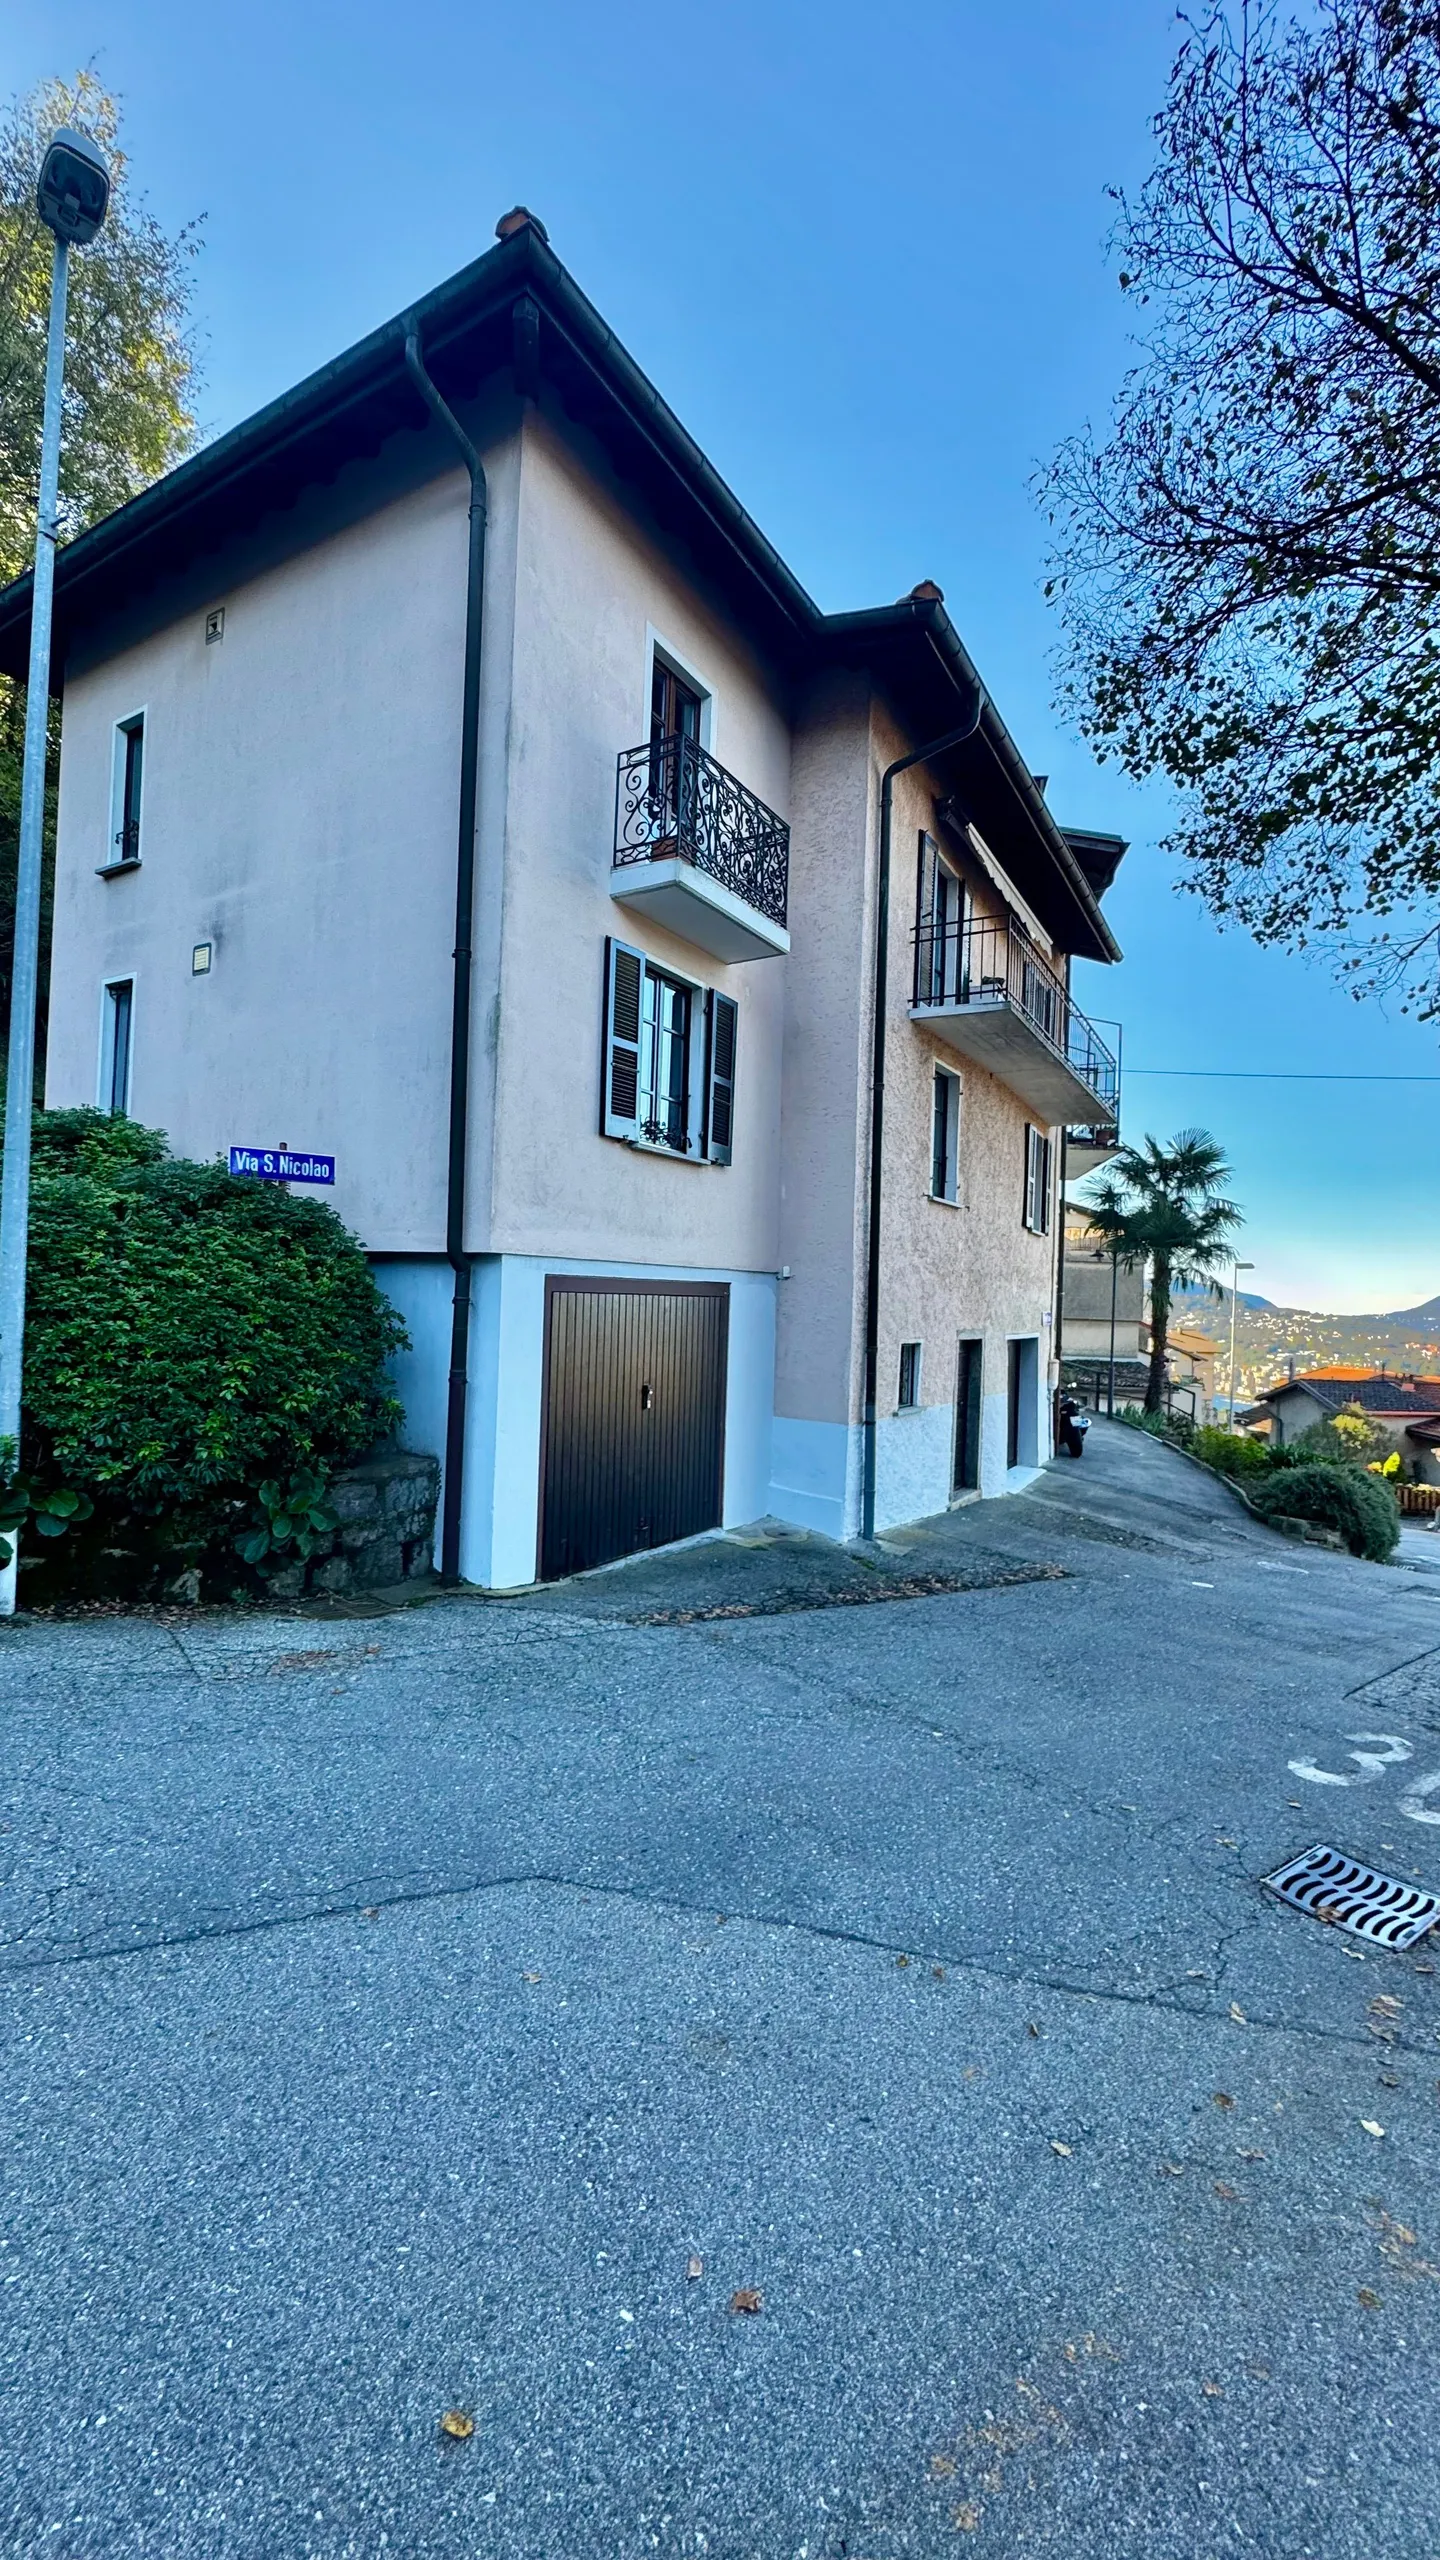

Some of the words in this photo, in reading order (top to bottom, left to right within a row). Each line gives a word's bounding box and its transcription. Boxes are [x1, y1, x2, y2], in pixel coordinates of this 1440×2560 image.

[235, 1150, 258, 1172] Via
[263, 1153, 277, 1173] S.
[279, 1155, 330, 1178] Nicolao
